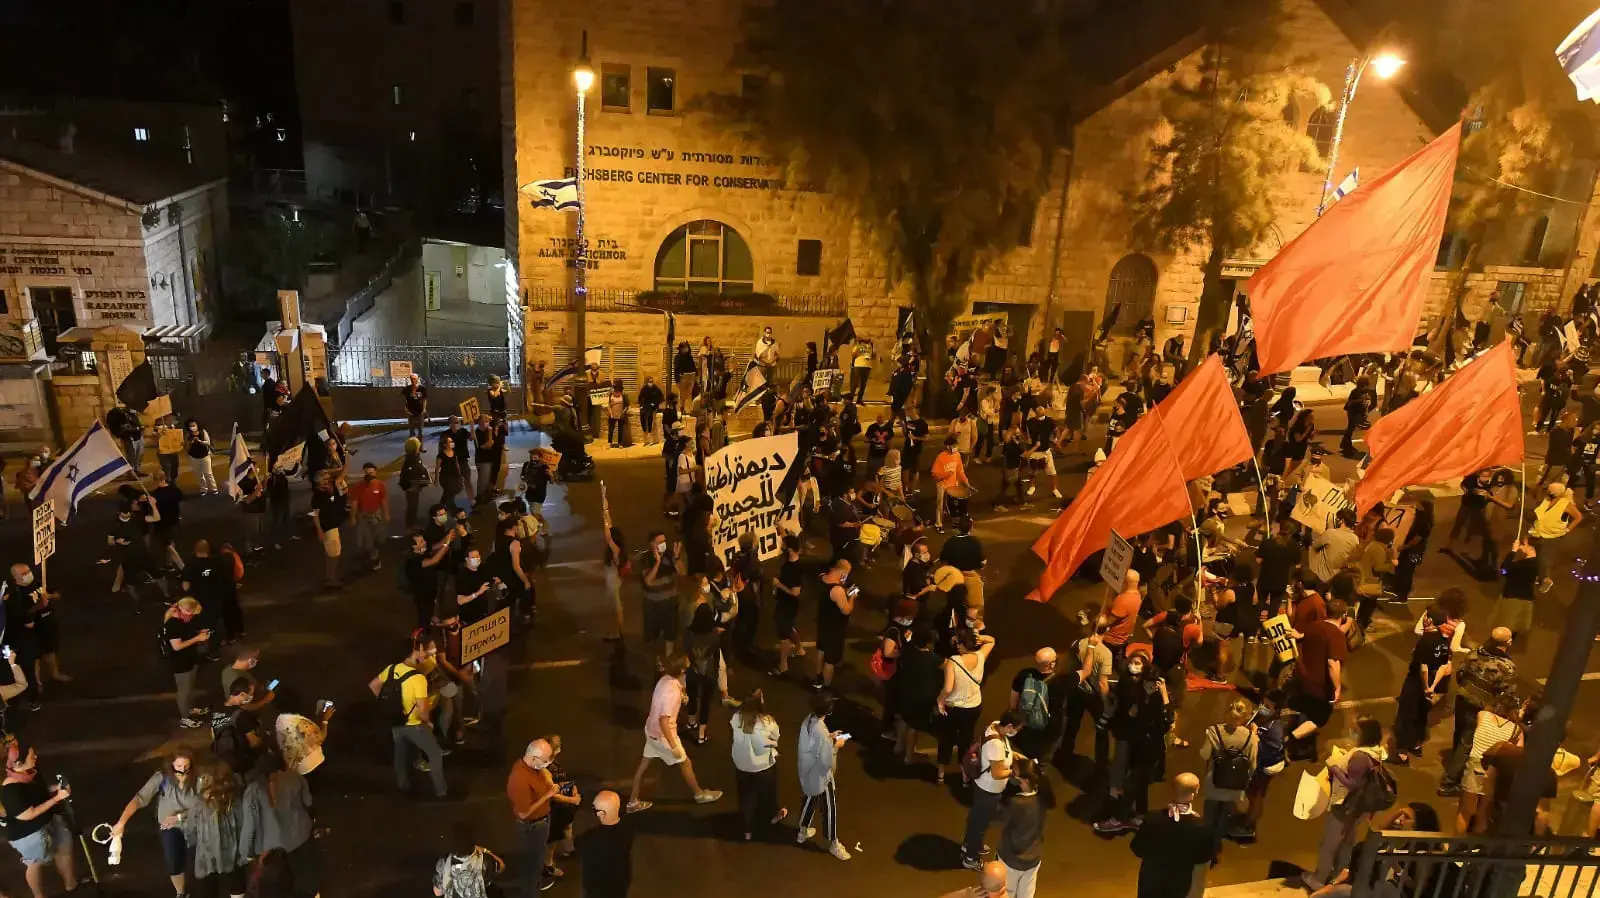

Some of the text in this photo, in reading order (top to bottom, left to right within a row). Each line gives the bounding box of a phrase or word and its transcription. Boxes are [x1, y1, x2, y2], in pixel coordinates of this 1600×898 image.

[588, 146, 646, 161] פיוקסברג
[682, 151, 734, 165] מסורתית
[637, 171, 682, 186] CENTER
[685, 174, 709, 188] FOR
[598, 239, 618, 249] בית
[537, 248, 565, 258] ALAN
[30, 266, 66, 275] הכנסת
[73, 266, 93, 275] בתי
[127, 291, 146, 299] בית
[87, 302, 147, 310] RAPAPORT
[101, 311, 136, 319] HOUSE
[463, 399, 478, 420] 175
[706, 451, 787, 497] ديمقراطية
